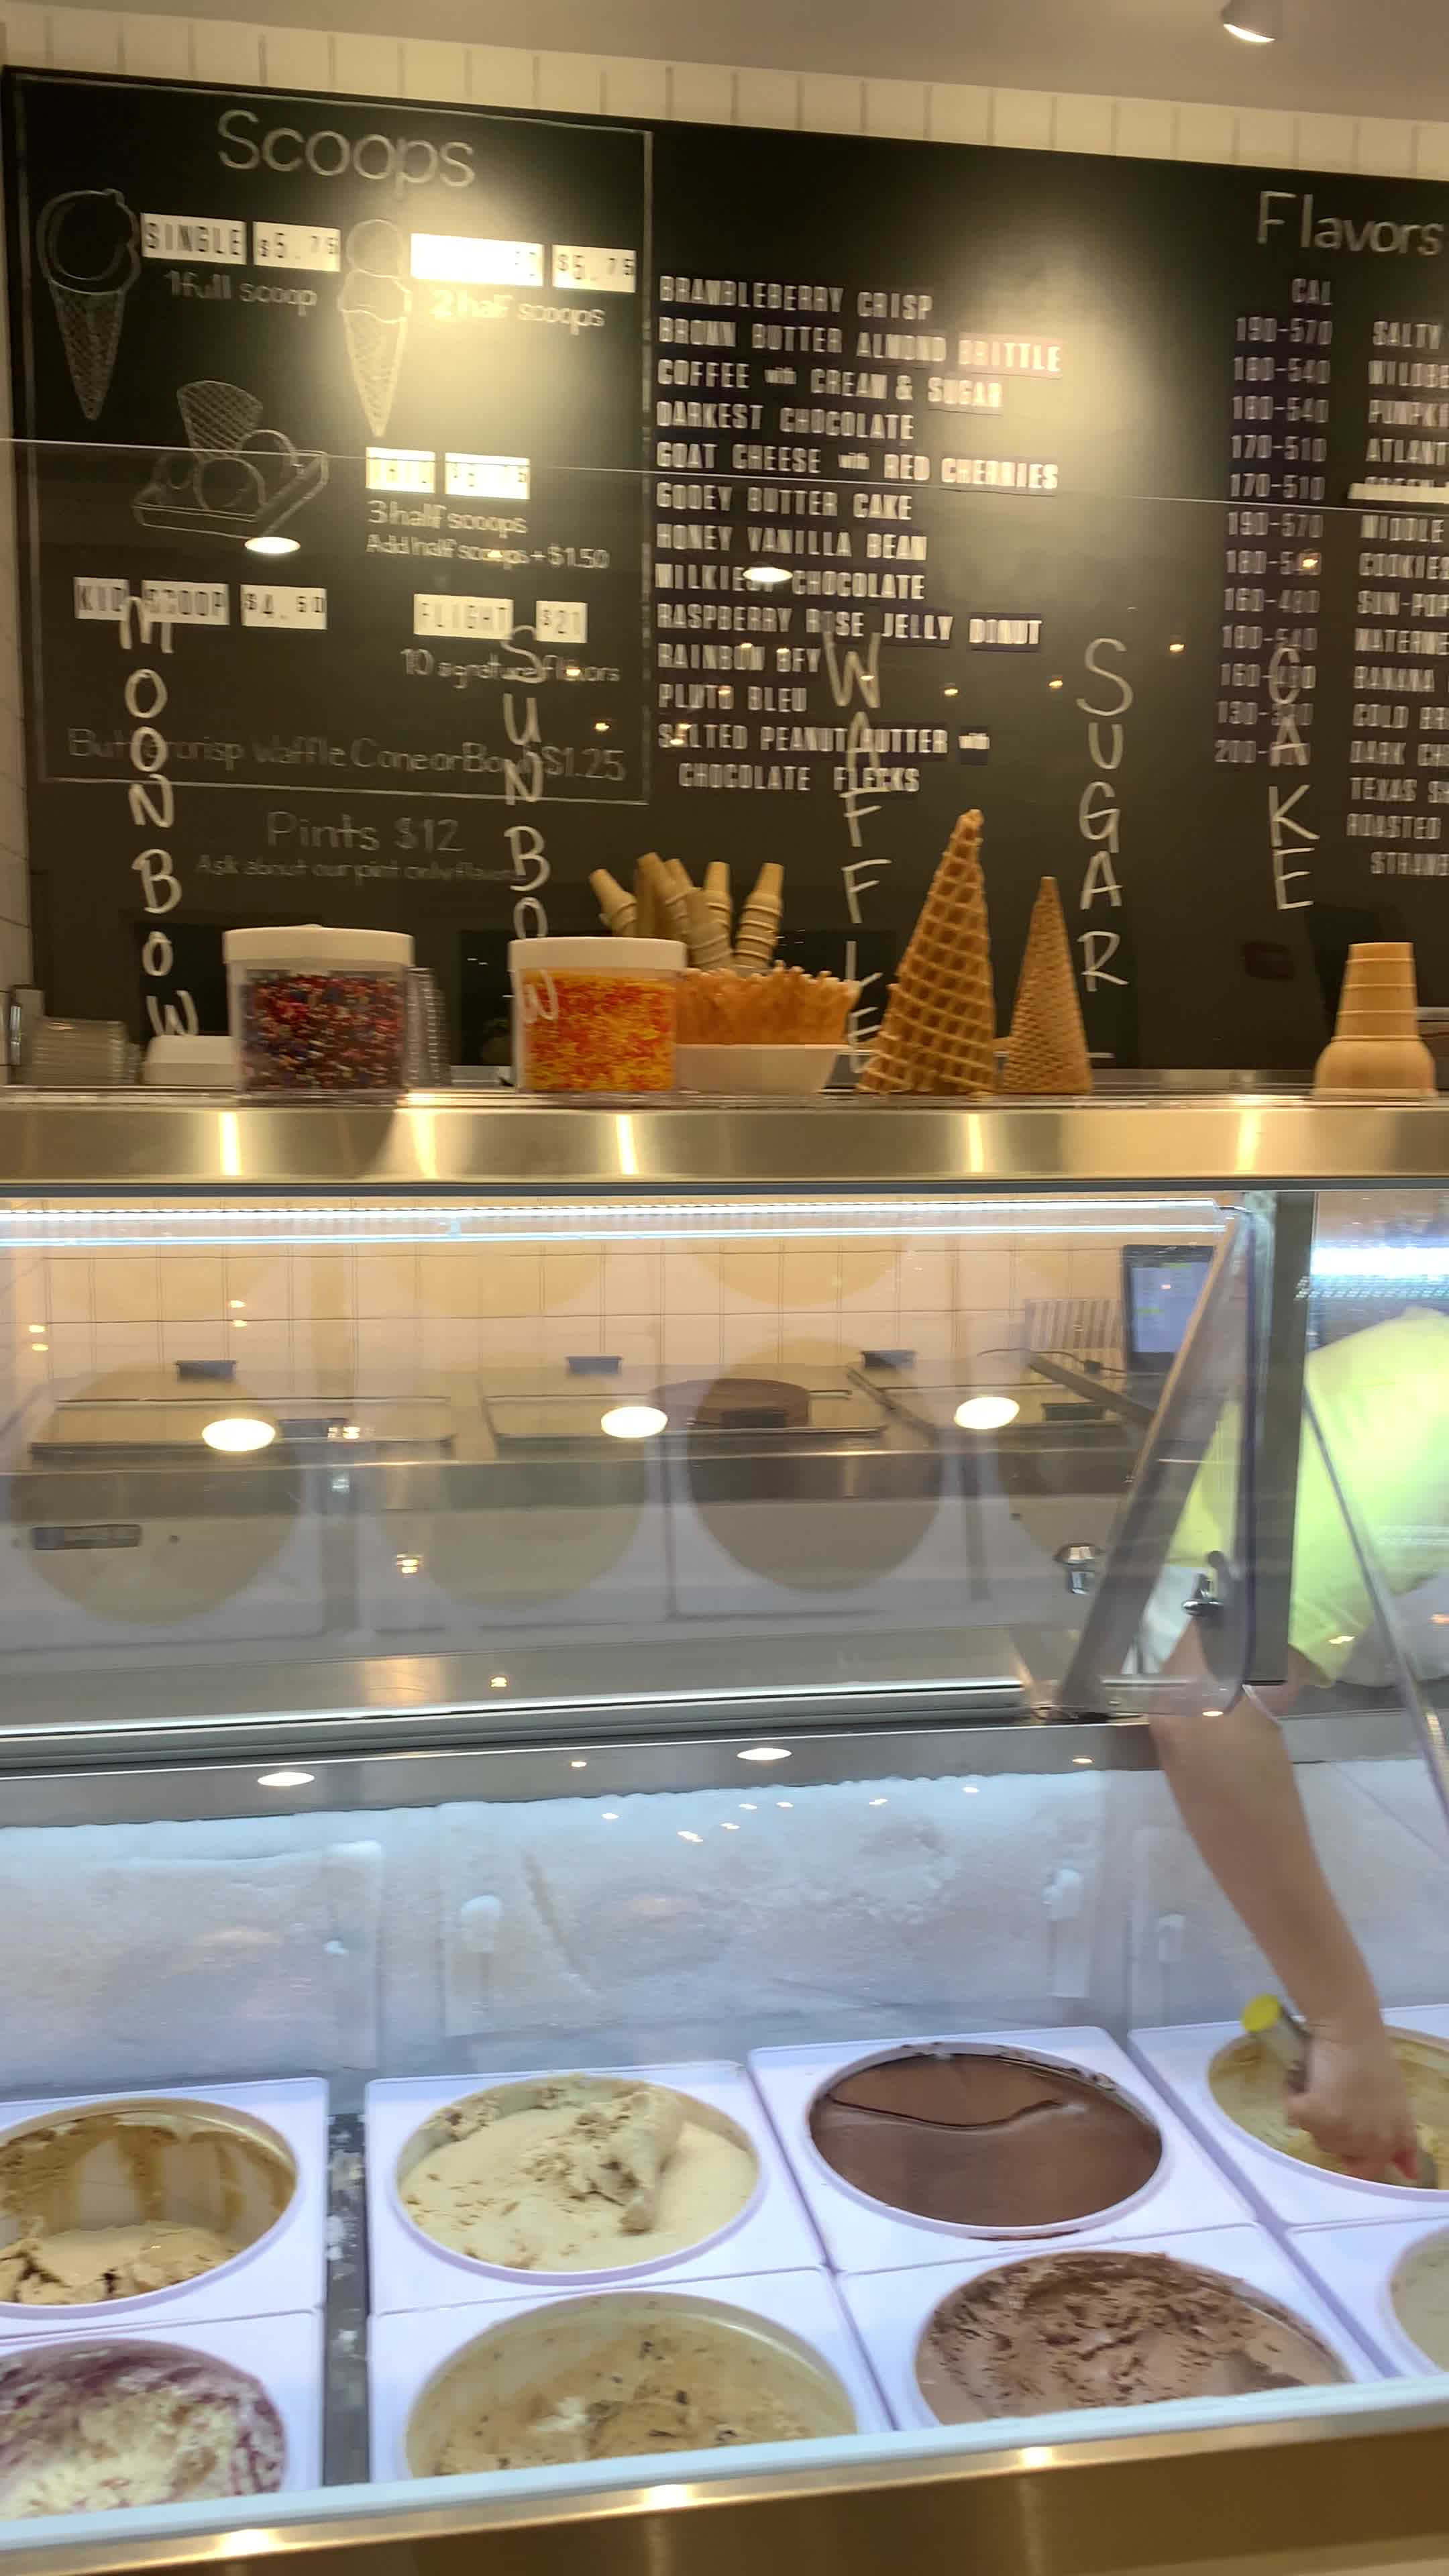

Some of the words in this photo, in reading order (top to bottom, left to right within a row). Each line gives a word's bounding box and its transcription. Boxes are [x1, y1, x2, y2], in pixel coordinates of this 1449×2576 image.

[217, 109, 475, 197] Scoops
[146, 222, 243, 256] SINGLE
[1257, 191, 1444, 256] Flavors
[239, 280, 317, 317] scoop
[660, 276, 843, 313] BRAMBLEBERRY
[857, 291, 933, 320] CRISP
[517, 302, 606, 335] scoops
[1373, 320, 1440, 350] SALTY
[659, 317, 736, 347] BROWN
[751, 323, 842, 353] BUTTER
[857, 332, 947, 362] ALMOND
[958, 339, 1061, 372] BRITTLE
[657, 359, 749, 388] COFFEE
[810, 368, 887, 399] CREAM
[896, 375, 913, 400] &
[928, 376, 1002, 408] SUGAR
[657, 400, 764, 430] DARKEST
[780, 407, 914, 439] CHOCOLATE
[657, 441, 718, 469] GOAT
[733, 443, 821, 473] CHEESE
[884, 453, 930, 481] RED
[941, 458, 1058, 489] CHERRIES
[367, 500, 387, 525] 3
[389, 501, 447, 529] half
[448, 512, 528, 538] scoops
[657, 482, 733, 511] GOOEY
[747, 486, 837, 516] BUTTER
[853, 493, 912, 520] CAKE
[547, 543, 611, 570] $1.50
[657, 523, 733, 551] HONEY
[747, 527, 852, 557] VANILLA
[867, 533, 927, 560] BEAN
[792, 570, 924, 600] CHOCOLATE
[657, 603, 792, 633] RASPBERRY
[881, 612, 953, 640] JELLY
[400, 648, 435, 676] 10
[657, 643, 765, 670] RAINBOW
[658, 683, 734, 709] PLUTO
[748, 686, 806, 712] BLEU
[351, 737, 429, 771] Cone
[541, 745, 627, 782] $1.25
[679, 763, 810, 792] CHOCOLATE
[1268, 647, 1322, 910] CAKE
[1349, 776, 1417, 802] TEXAS
[267, 810, 380, 851] Pints
[394, 816, 465, 853] $12
[1075, 637, 1134, 991] SUGAR
